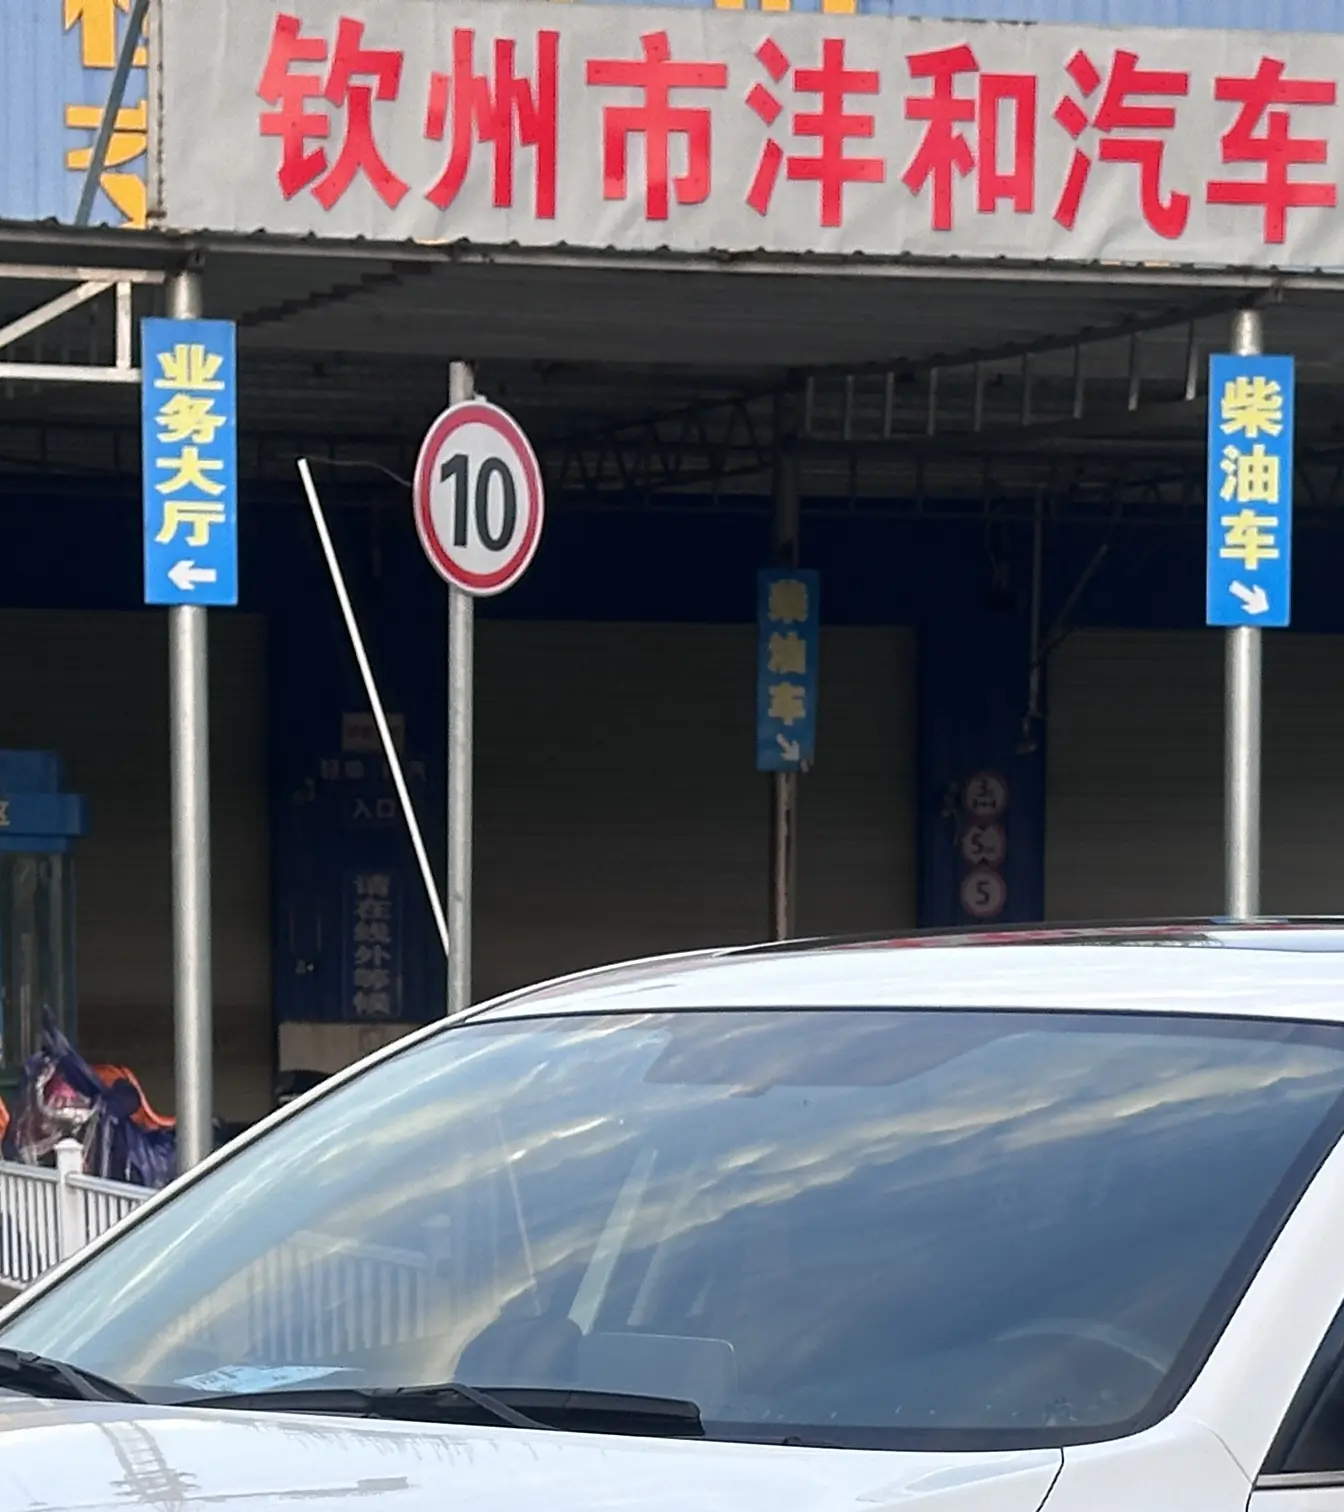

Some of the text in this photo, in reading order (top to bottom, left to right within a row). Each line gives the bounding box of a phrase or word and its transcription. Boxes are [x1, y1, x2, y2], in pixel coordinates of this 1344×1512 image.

[154, 343, 227, 547] 业务大厅
[439, 453, 517, 552] 10
[1219, 376, 1284, 570] 柴油车
